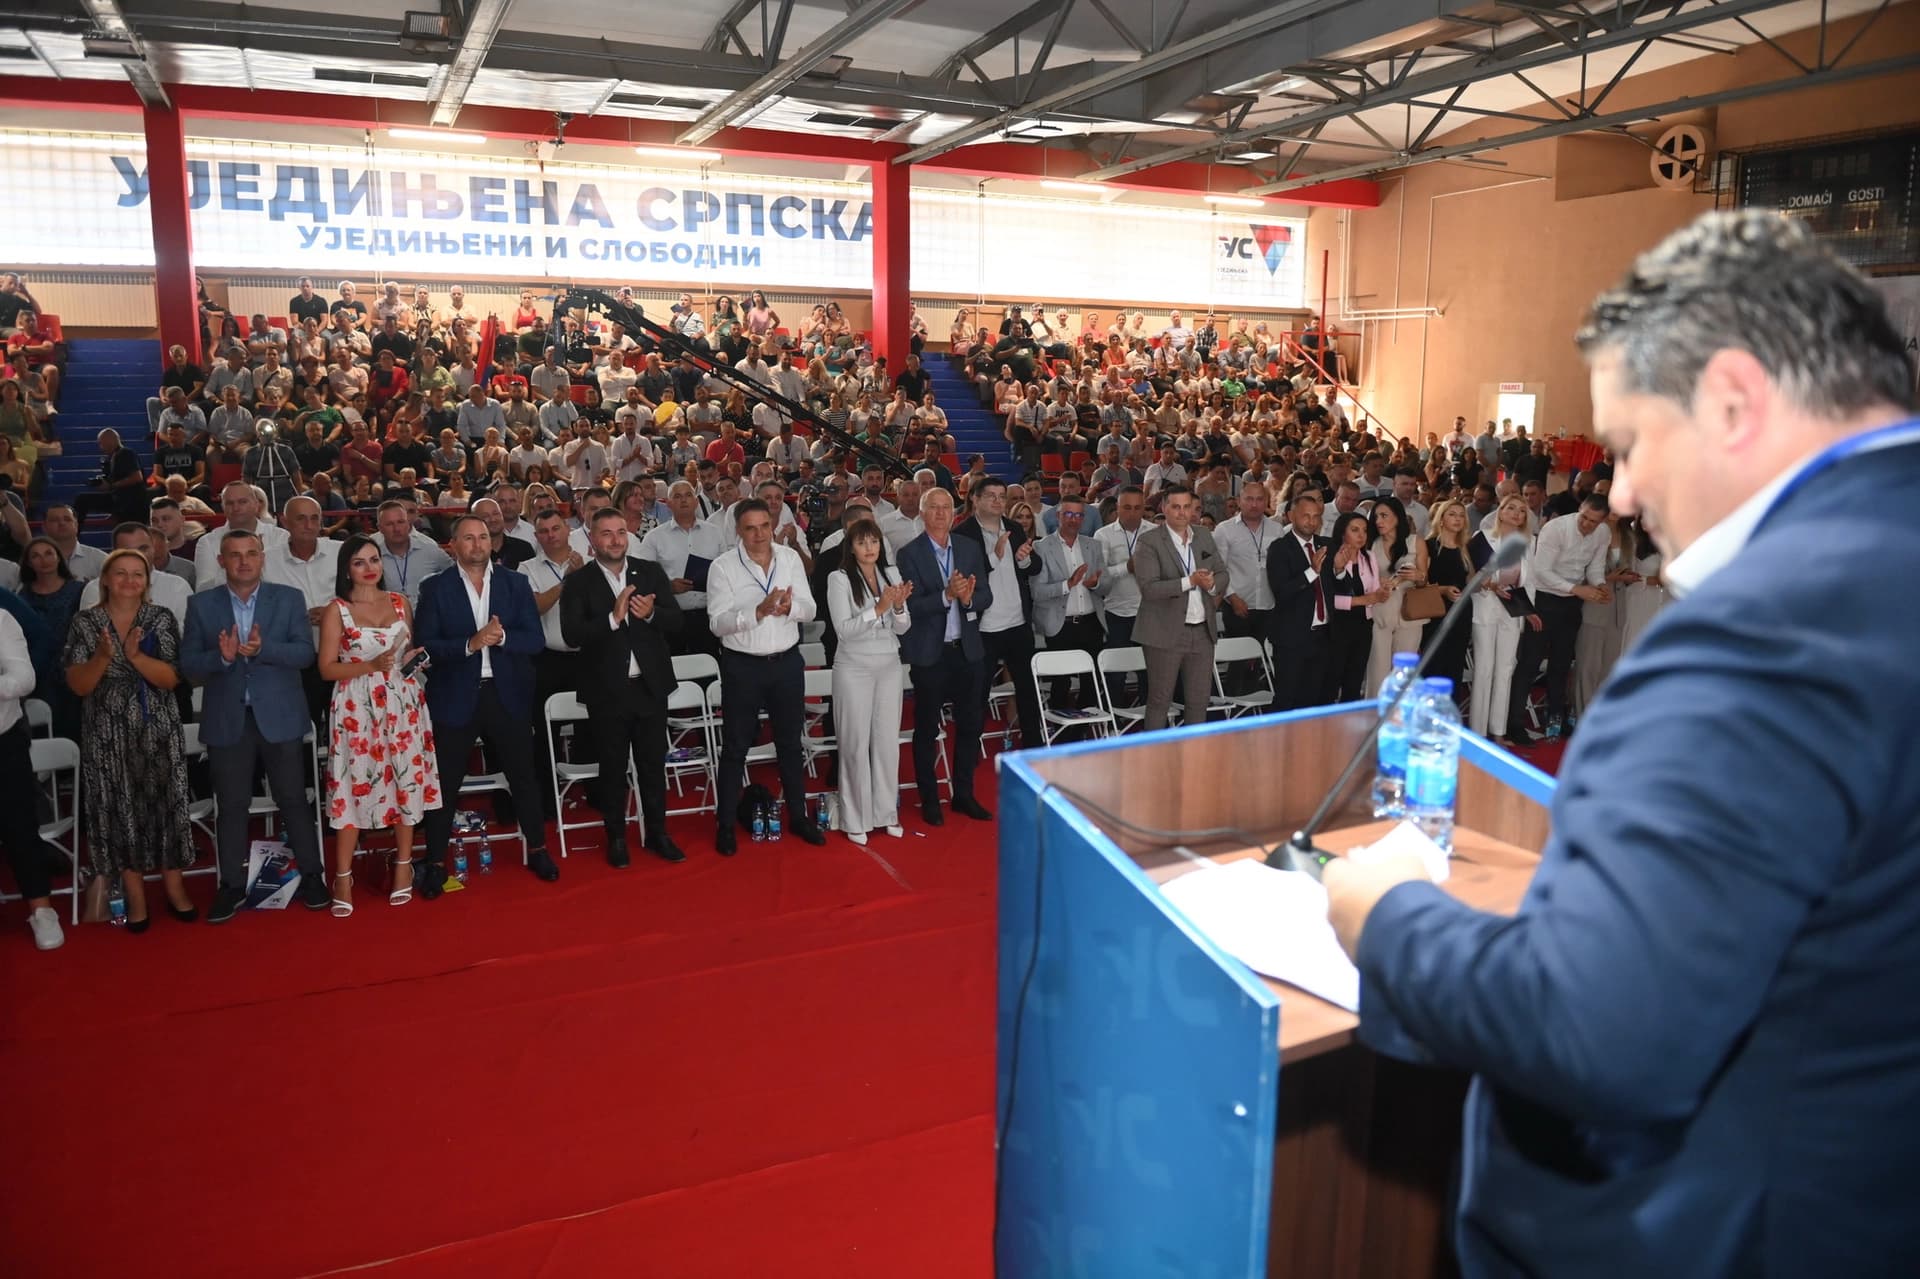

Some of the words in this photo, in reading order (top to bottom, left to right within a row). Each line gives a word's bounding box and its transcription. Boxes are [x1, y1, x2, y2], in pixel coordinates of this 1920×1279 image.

[110, 156, 615, 228] УЈЕДИЊЕНА
[1788, 189, 1833, 208] DOMAĆI
[1848, 187, 1884, 202] GOSTI
[297, 225, 532, 257] УЈЕДИЊЕНИ
[545, 236, 567, 258] И
[579, 238, 761, 269] СЛОБОДНИ
